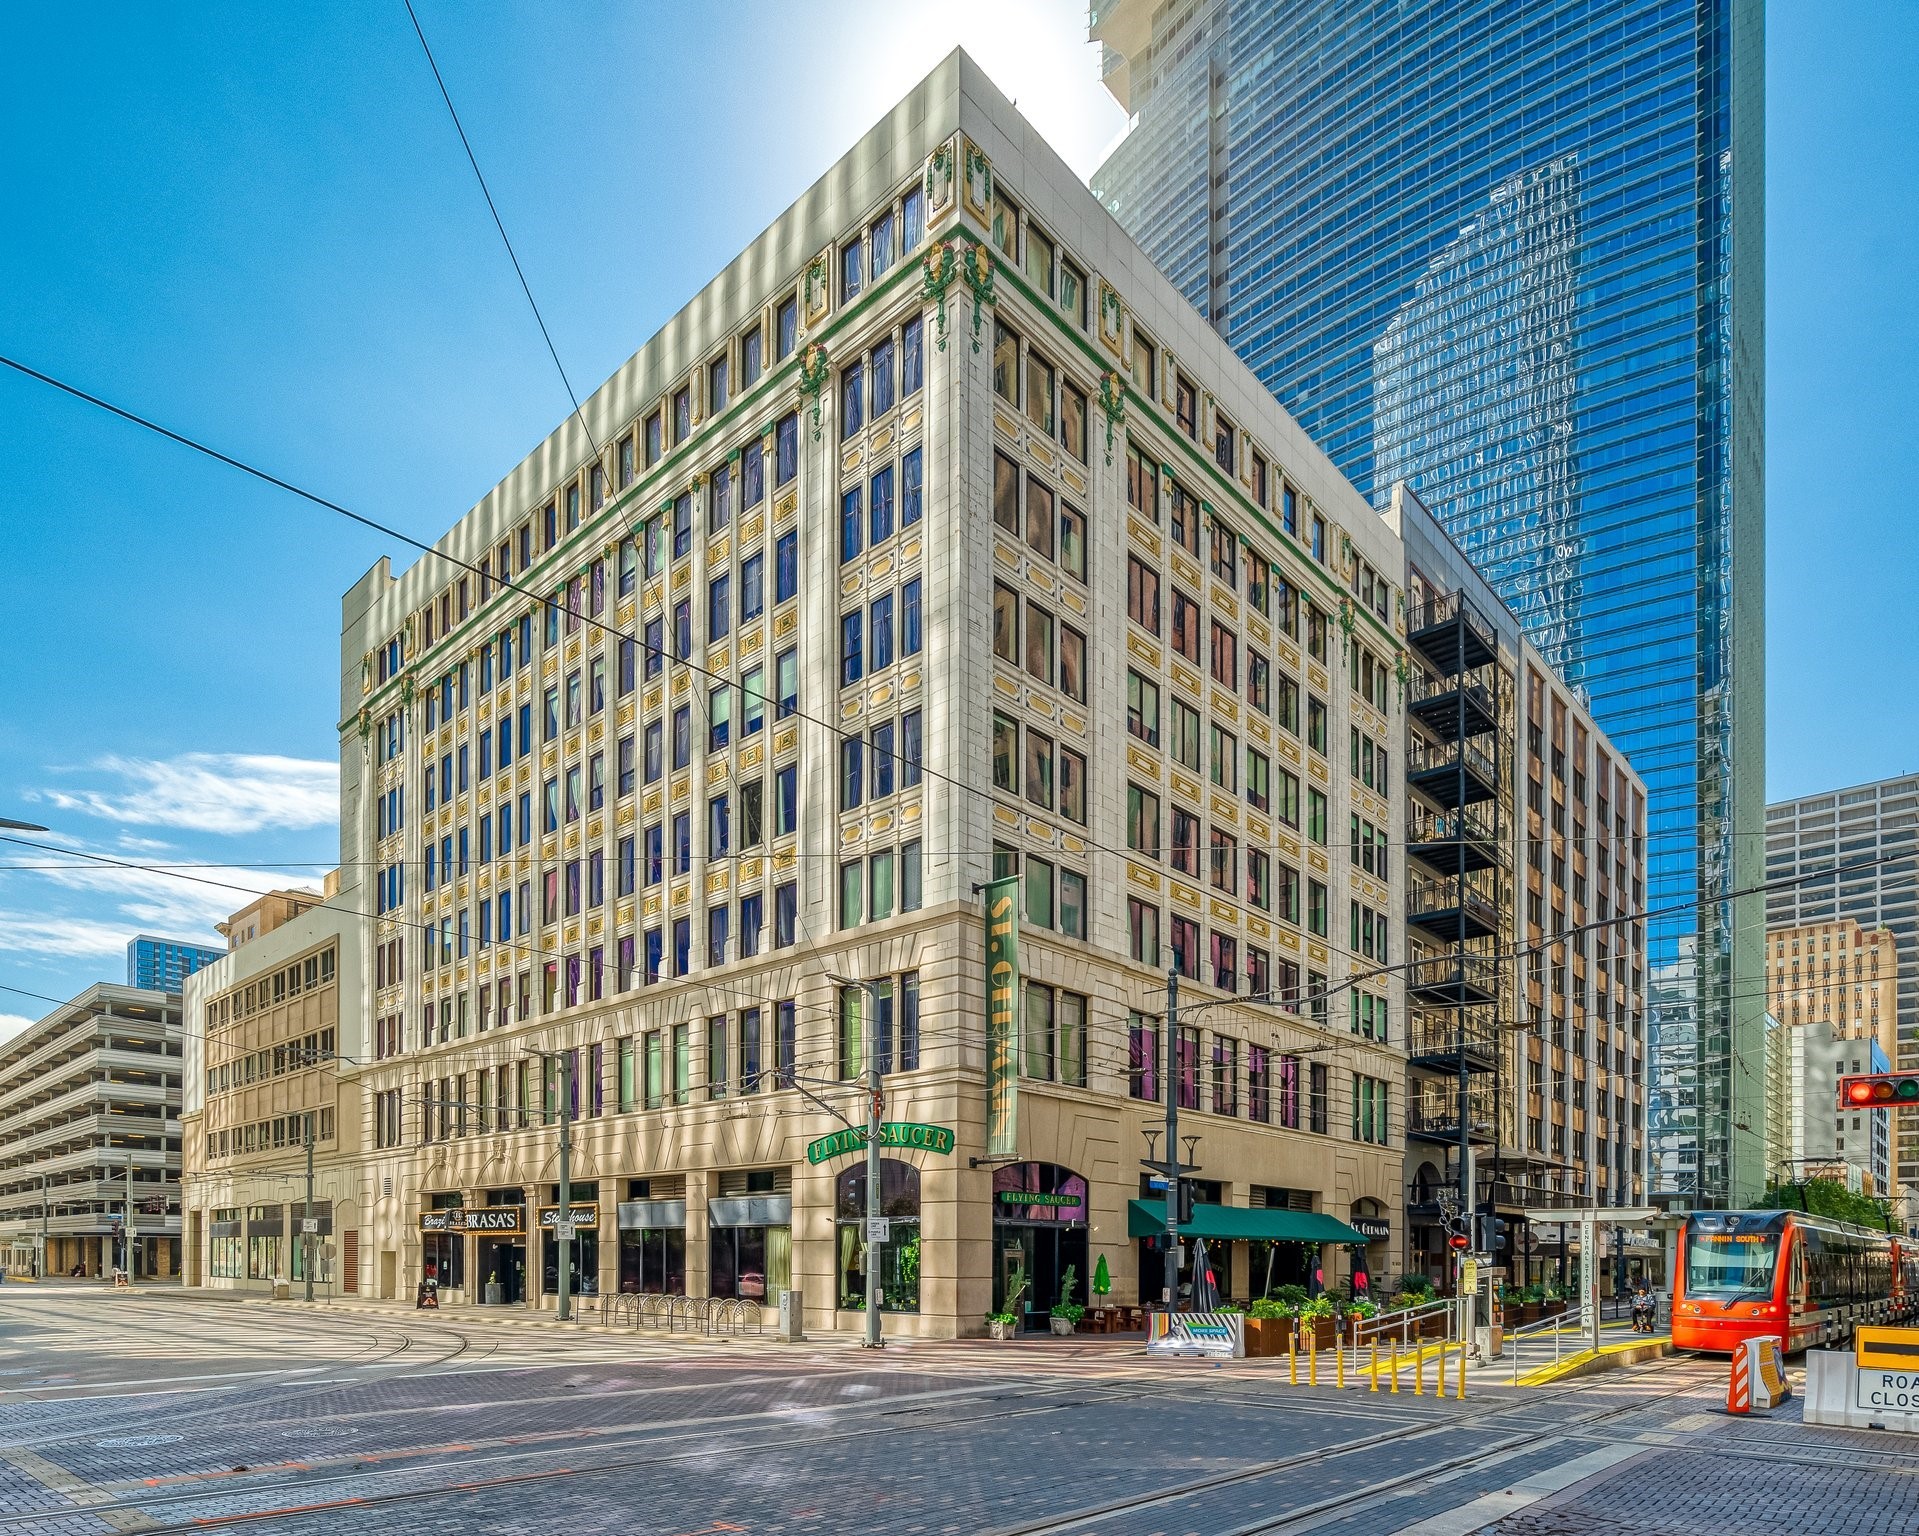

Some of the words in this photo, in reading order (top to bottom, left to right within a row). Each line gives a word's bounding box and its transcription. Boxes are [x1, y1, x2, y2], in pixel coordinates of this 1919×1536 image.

[991, 896, 1012, 953] ST.
[991, 960, 1012, 1137] GERMAIN
[813, 1129, 869, 1160] FLYIN
[879, 1125, 948, 1150] SAUCER
[1006, 1192, 1040, 1203] FLYING
[1044, 1195, 1077, 1205] SAUCER
[424, 1214, 447, 1229] Brazi
[466, 1213, 516, 1228] BRASA'S
[543, 1209, 595, 1225] Stehouse
[1361, 1222, 1390, 1236] GERMAIN
[1735, 1235, 1759, 1243] SOUTH
[1882, 1374, 1919, 1390] ROA
[1871, 1391, 1919, 1408] CLOS
